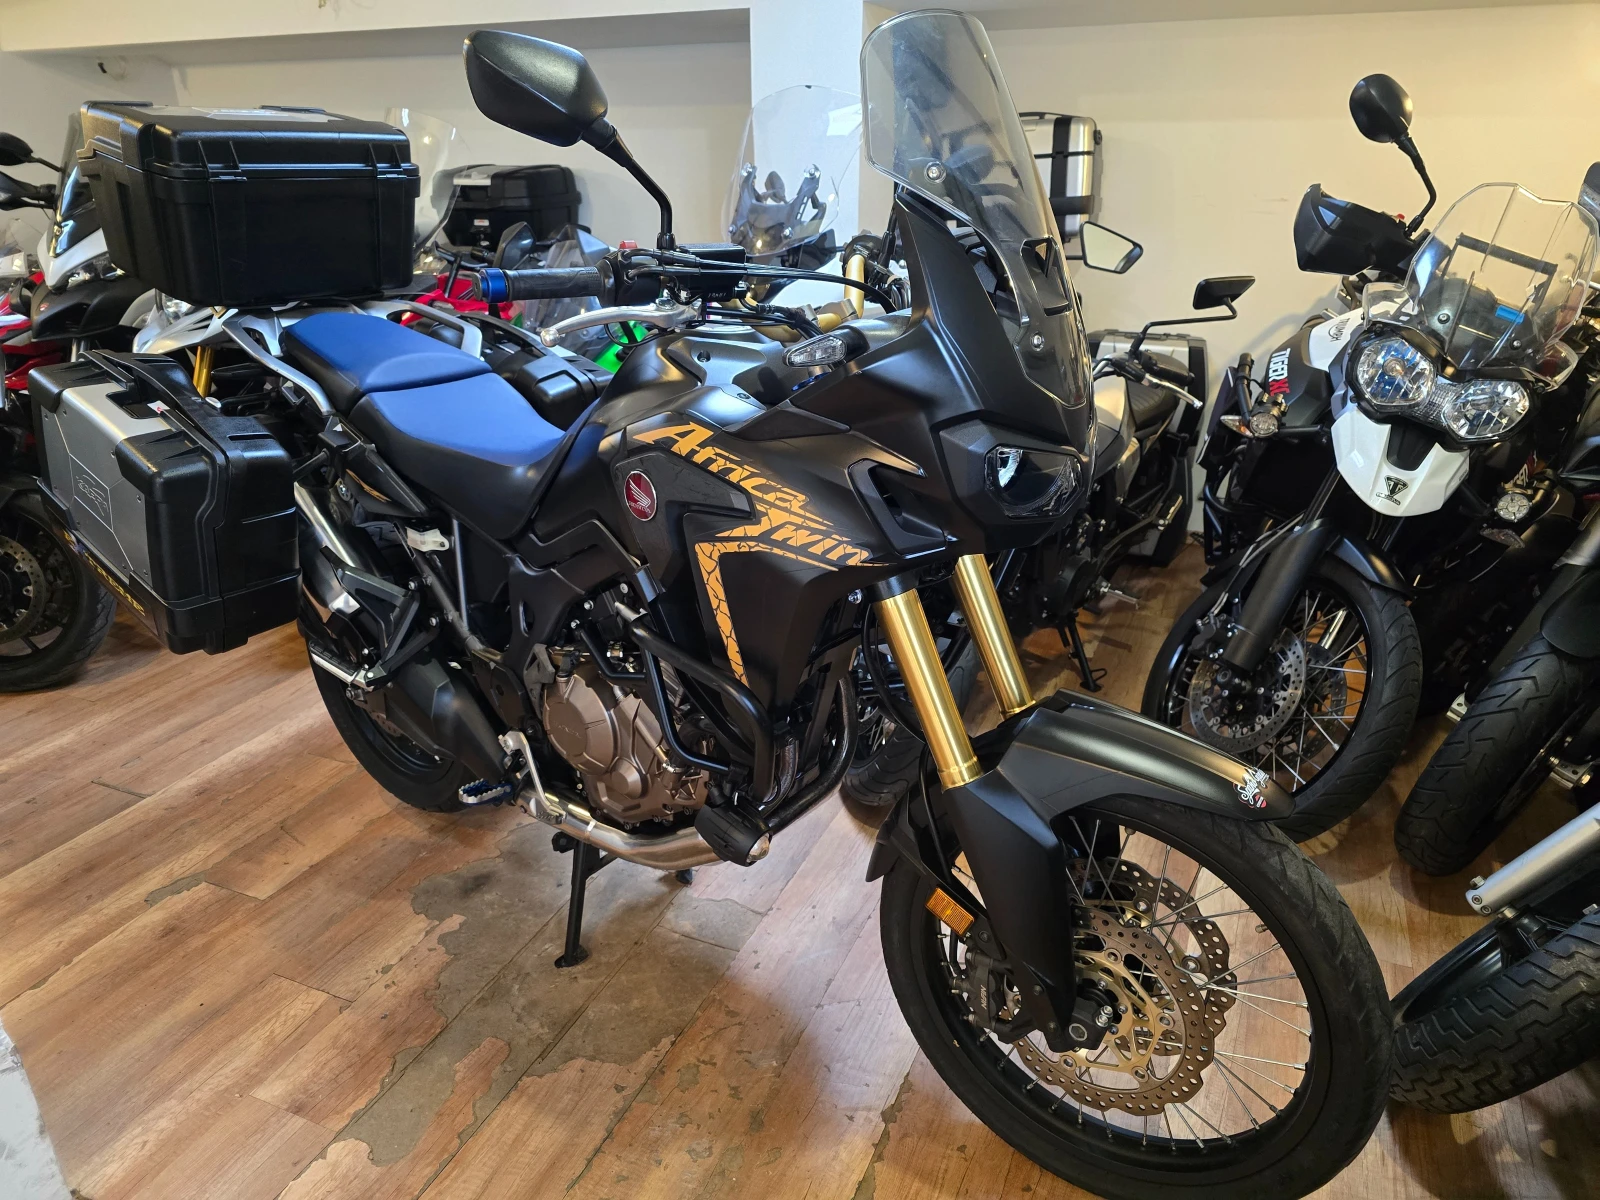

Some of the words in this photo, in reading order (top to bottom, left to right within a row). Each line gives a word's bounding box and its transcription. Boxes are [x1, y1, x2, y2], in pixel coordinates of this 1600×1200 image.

[1328, 317, 1351, 342] TRIUMPH
[1268, 347, 1292, 382] TIGER
[632, 421, 833, 526] Africa
[715, 501, 889, 567] Twin
